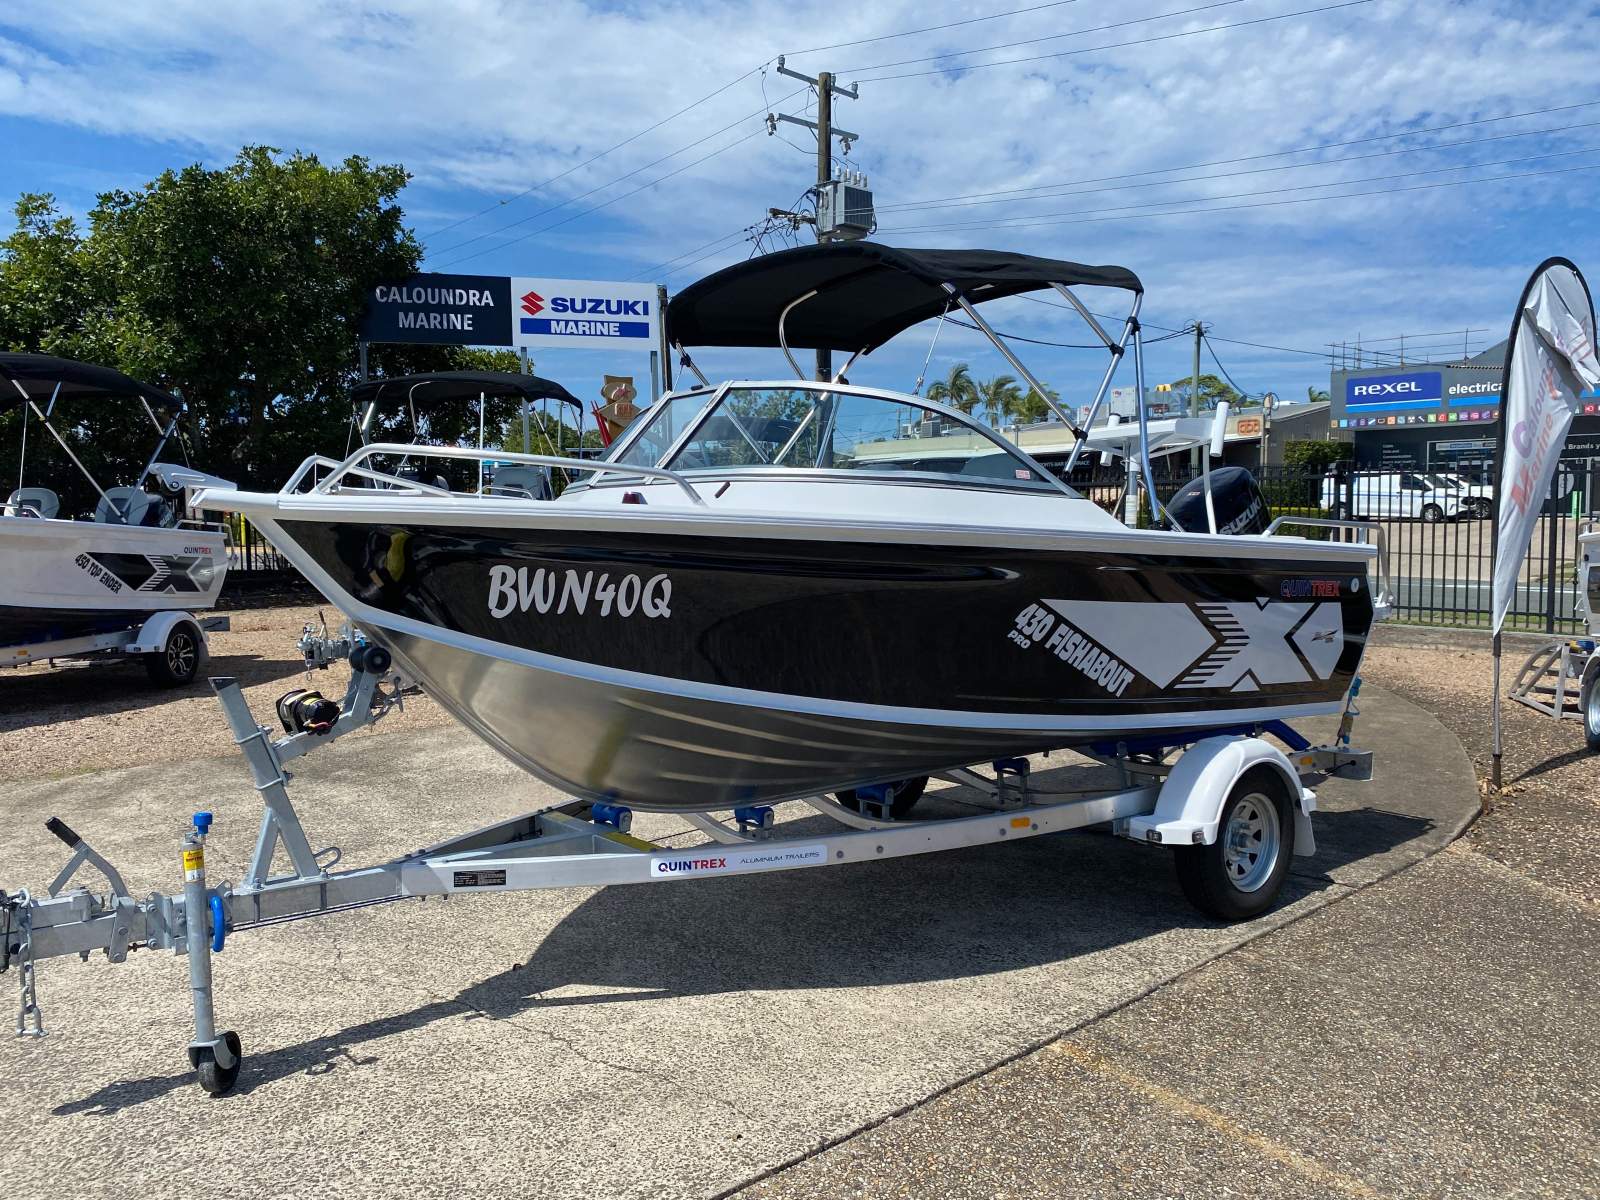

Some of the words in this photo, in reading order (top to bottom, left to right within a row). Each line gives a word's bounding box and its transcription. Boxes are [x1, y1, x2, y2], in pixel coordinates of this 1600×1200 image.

[375, 285, 495, 307] CALOUNDRA
[551, 297, 649, 316] SUZUKI
[398, 311, 474, 331] MARINE
[550, 320, 621, 336] MARINE
[183, 546, 212, 555] QUINTREX
[75, 553, 88, 570] 450
[89, 560, 102, 578] TOP
[99, 571, 122, 594] ENDER
[487, 564, 673, 619] BWN40Q
[1280, 579, 1341, 597] QUINTREX
[1007, 629, 1031, 649] PRO
[1014, 603, 1055, 642] 430
[1044, 623, 1136, 698] FISHABOUT
[657, 858, 727, 873] QUINTREX
[739, 855, 783, 864] ALUMINIUM
[785, 851, 820, 861] TRAILERS
